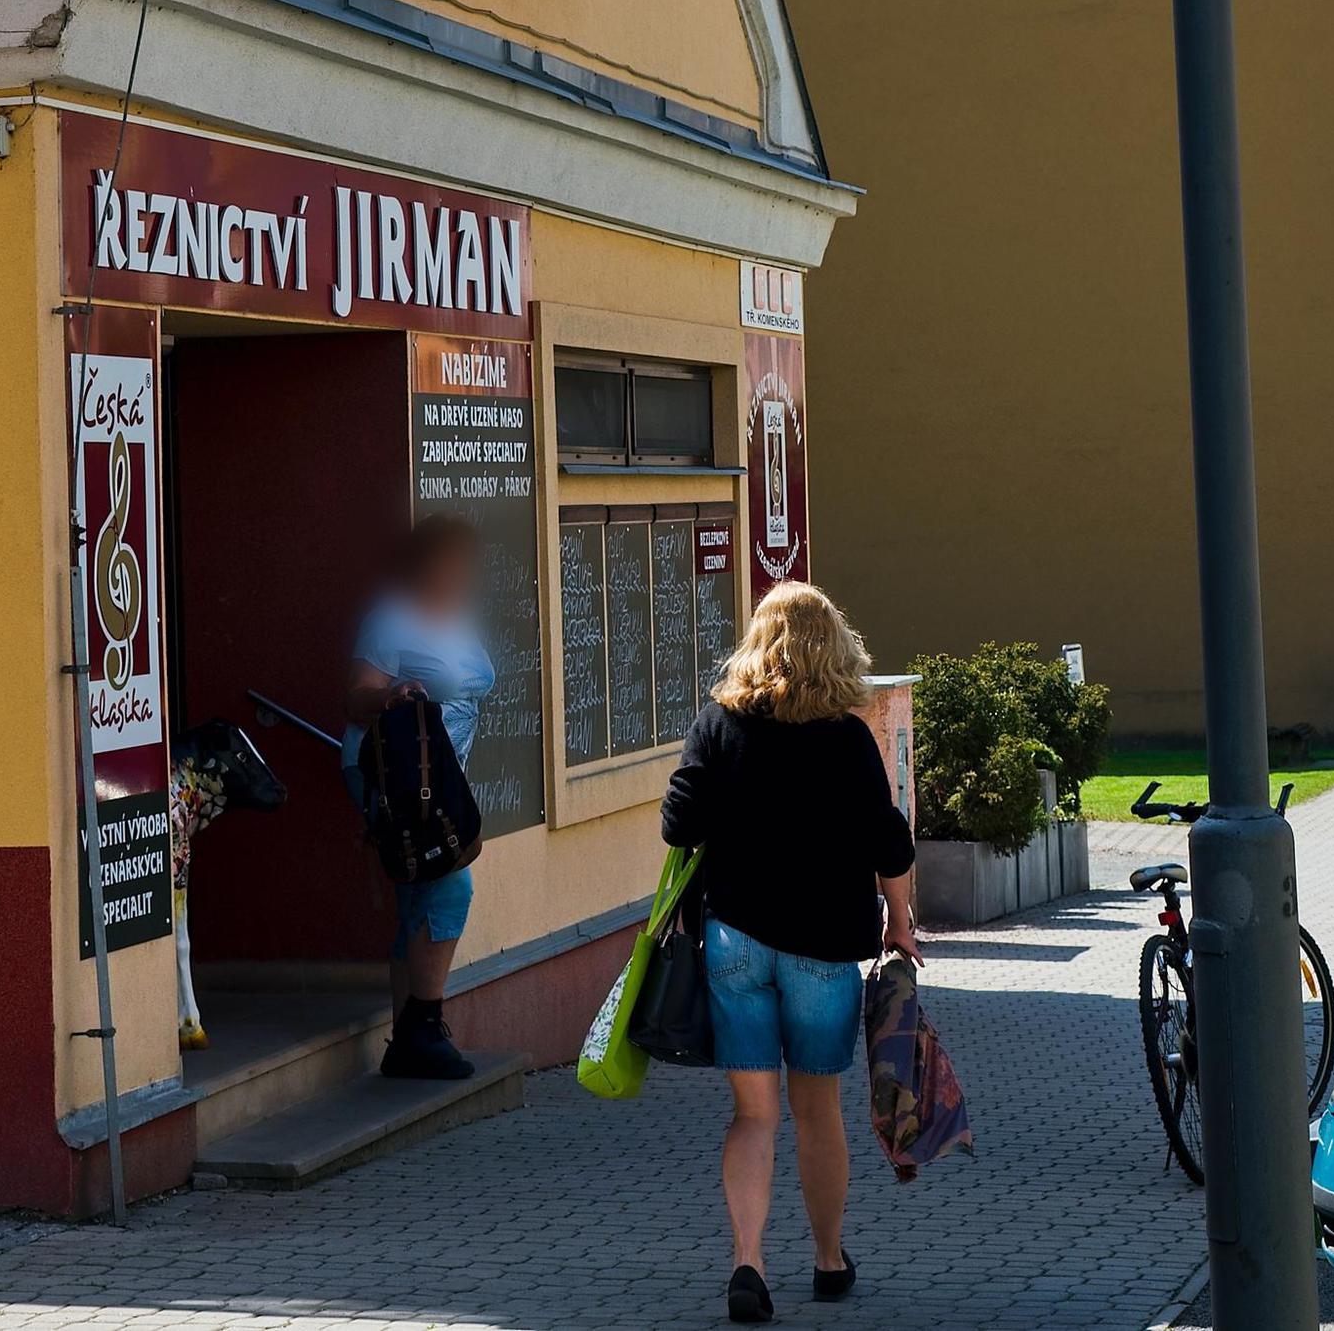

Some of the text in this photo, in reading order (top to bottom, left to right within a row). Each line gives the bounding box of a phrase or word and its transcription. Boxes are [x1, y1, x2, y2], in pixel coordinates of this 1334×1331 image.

[93, 167, 523, 318] ŘEZNICTVÍ JIRMAN
[441, 344, 508, 389] NABÍZÍME
[82, 367, 145, 436] Česká
[424, 399, 524, 429] NA DŘEVĚ UZENÉ MASO
[422, 435, 528, 467] ZABIJAČKOVÉ SPECIALITY
[419, 469, 532, 499] ŠUNKA KLOBÁSY PÁRKY
[90, 687, 153, 734] klasika
[81, 810, 169, 853] VASTNÍ VÝROBA
[89, 843, 164, 888] ZENÁŘSKÝCH
[103, 890, 154, 927] SPECIALIT
